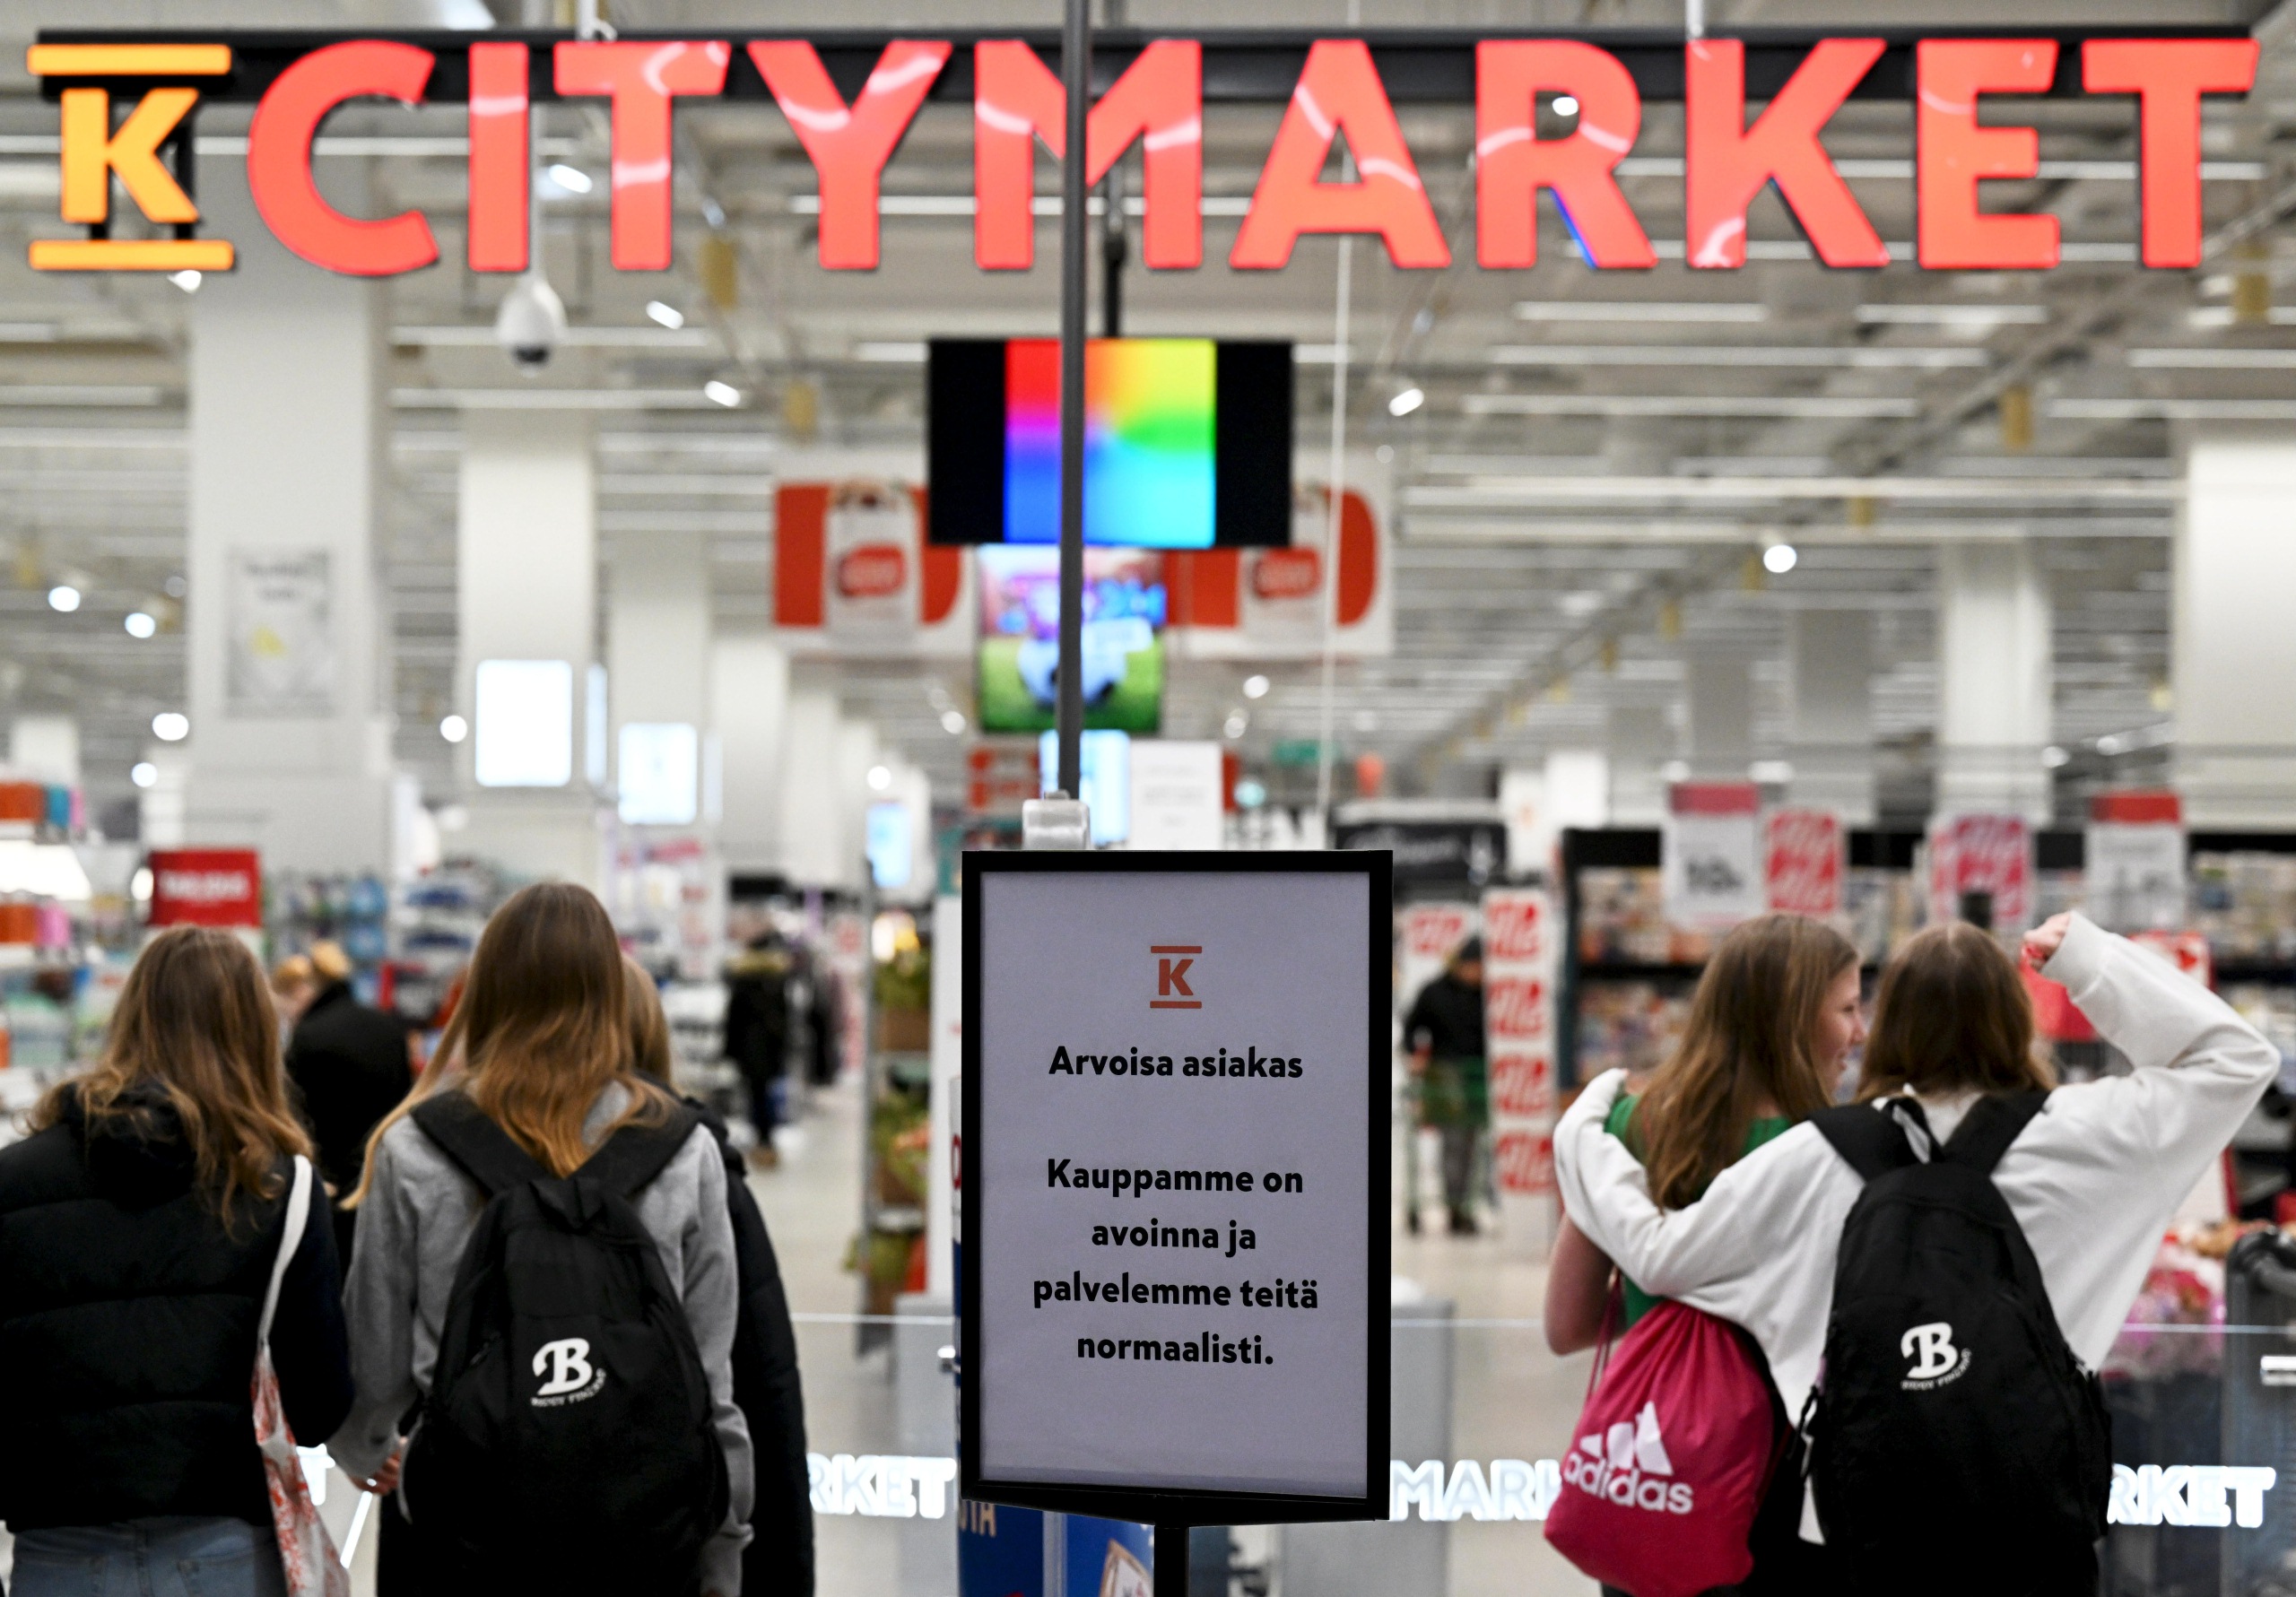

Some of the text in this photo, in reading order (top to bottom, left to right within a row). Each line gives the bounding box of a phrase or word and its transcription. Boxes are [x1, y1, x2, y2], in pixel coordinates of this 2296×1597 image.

[247, 39, 2259, 275] CITYMARKET
[1048, 1046, 1303, 1079] Arvoisa asiakas
[1048, 1158, 1303, 1199] Kauppamme on
[1091, 1217, 1257, 1258] avoinna ja
[1033, 1270, 1318, 1309] palvelemme teitä
[1077, 1331, 1274, 1366] normaalisti.
[1562, 1451, 1694, 1515] adidas
